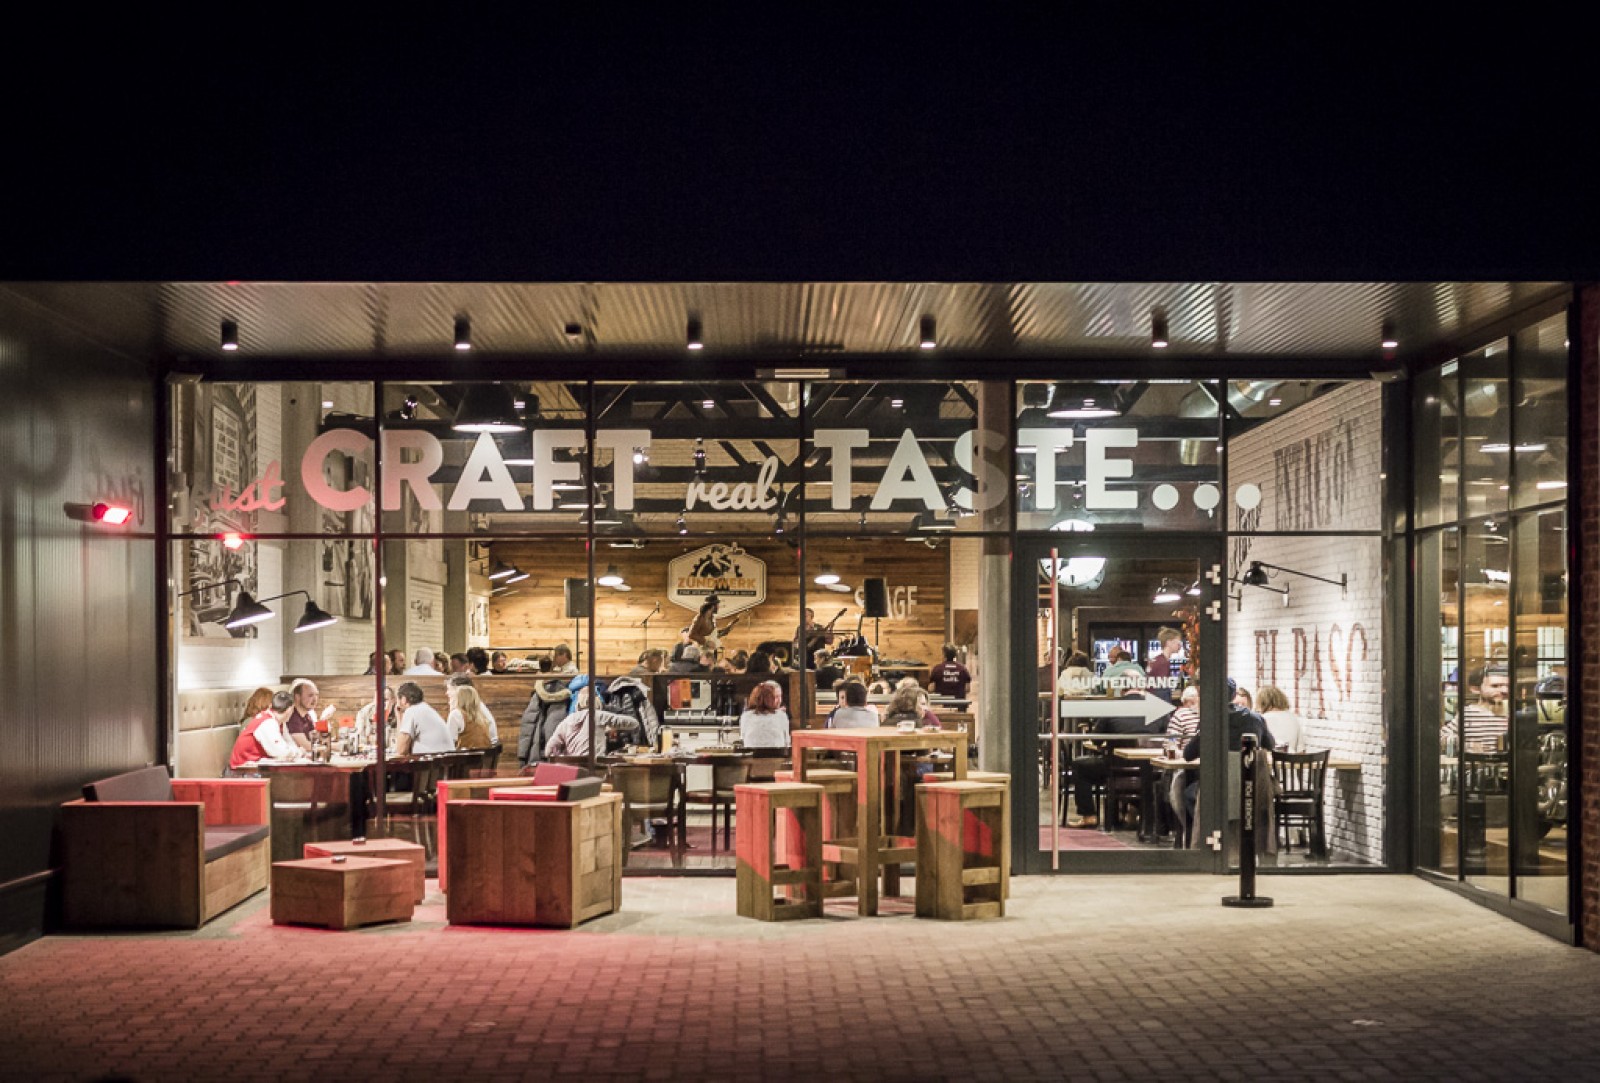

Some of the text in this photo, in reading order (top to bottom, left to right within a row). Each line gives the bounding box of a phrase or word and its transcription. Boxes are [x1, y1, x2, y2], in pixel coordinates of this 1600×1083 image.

[301, 427, 652, 511] CRAFT
[686, 456, 780, 511] real
[854, 585, 918, 620] SAGE
[1062, 676, 1179, 689] AUPTEINGANG
